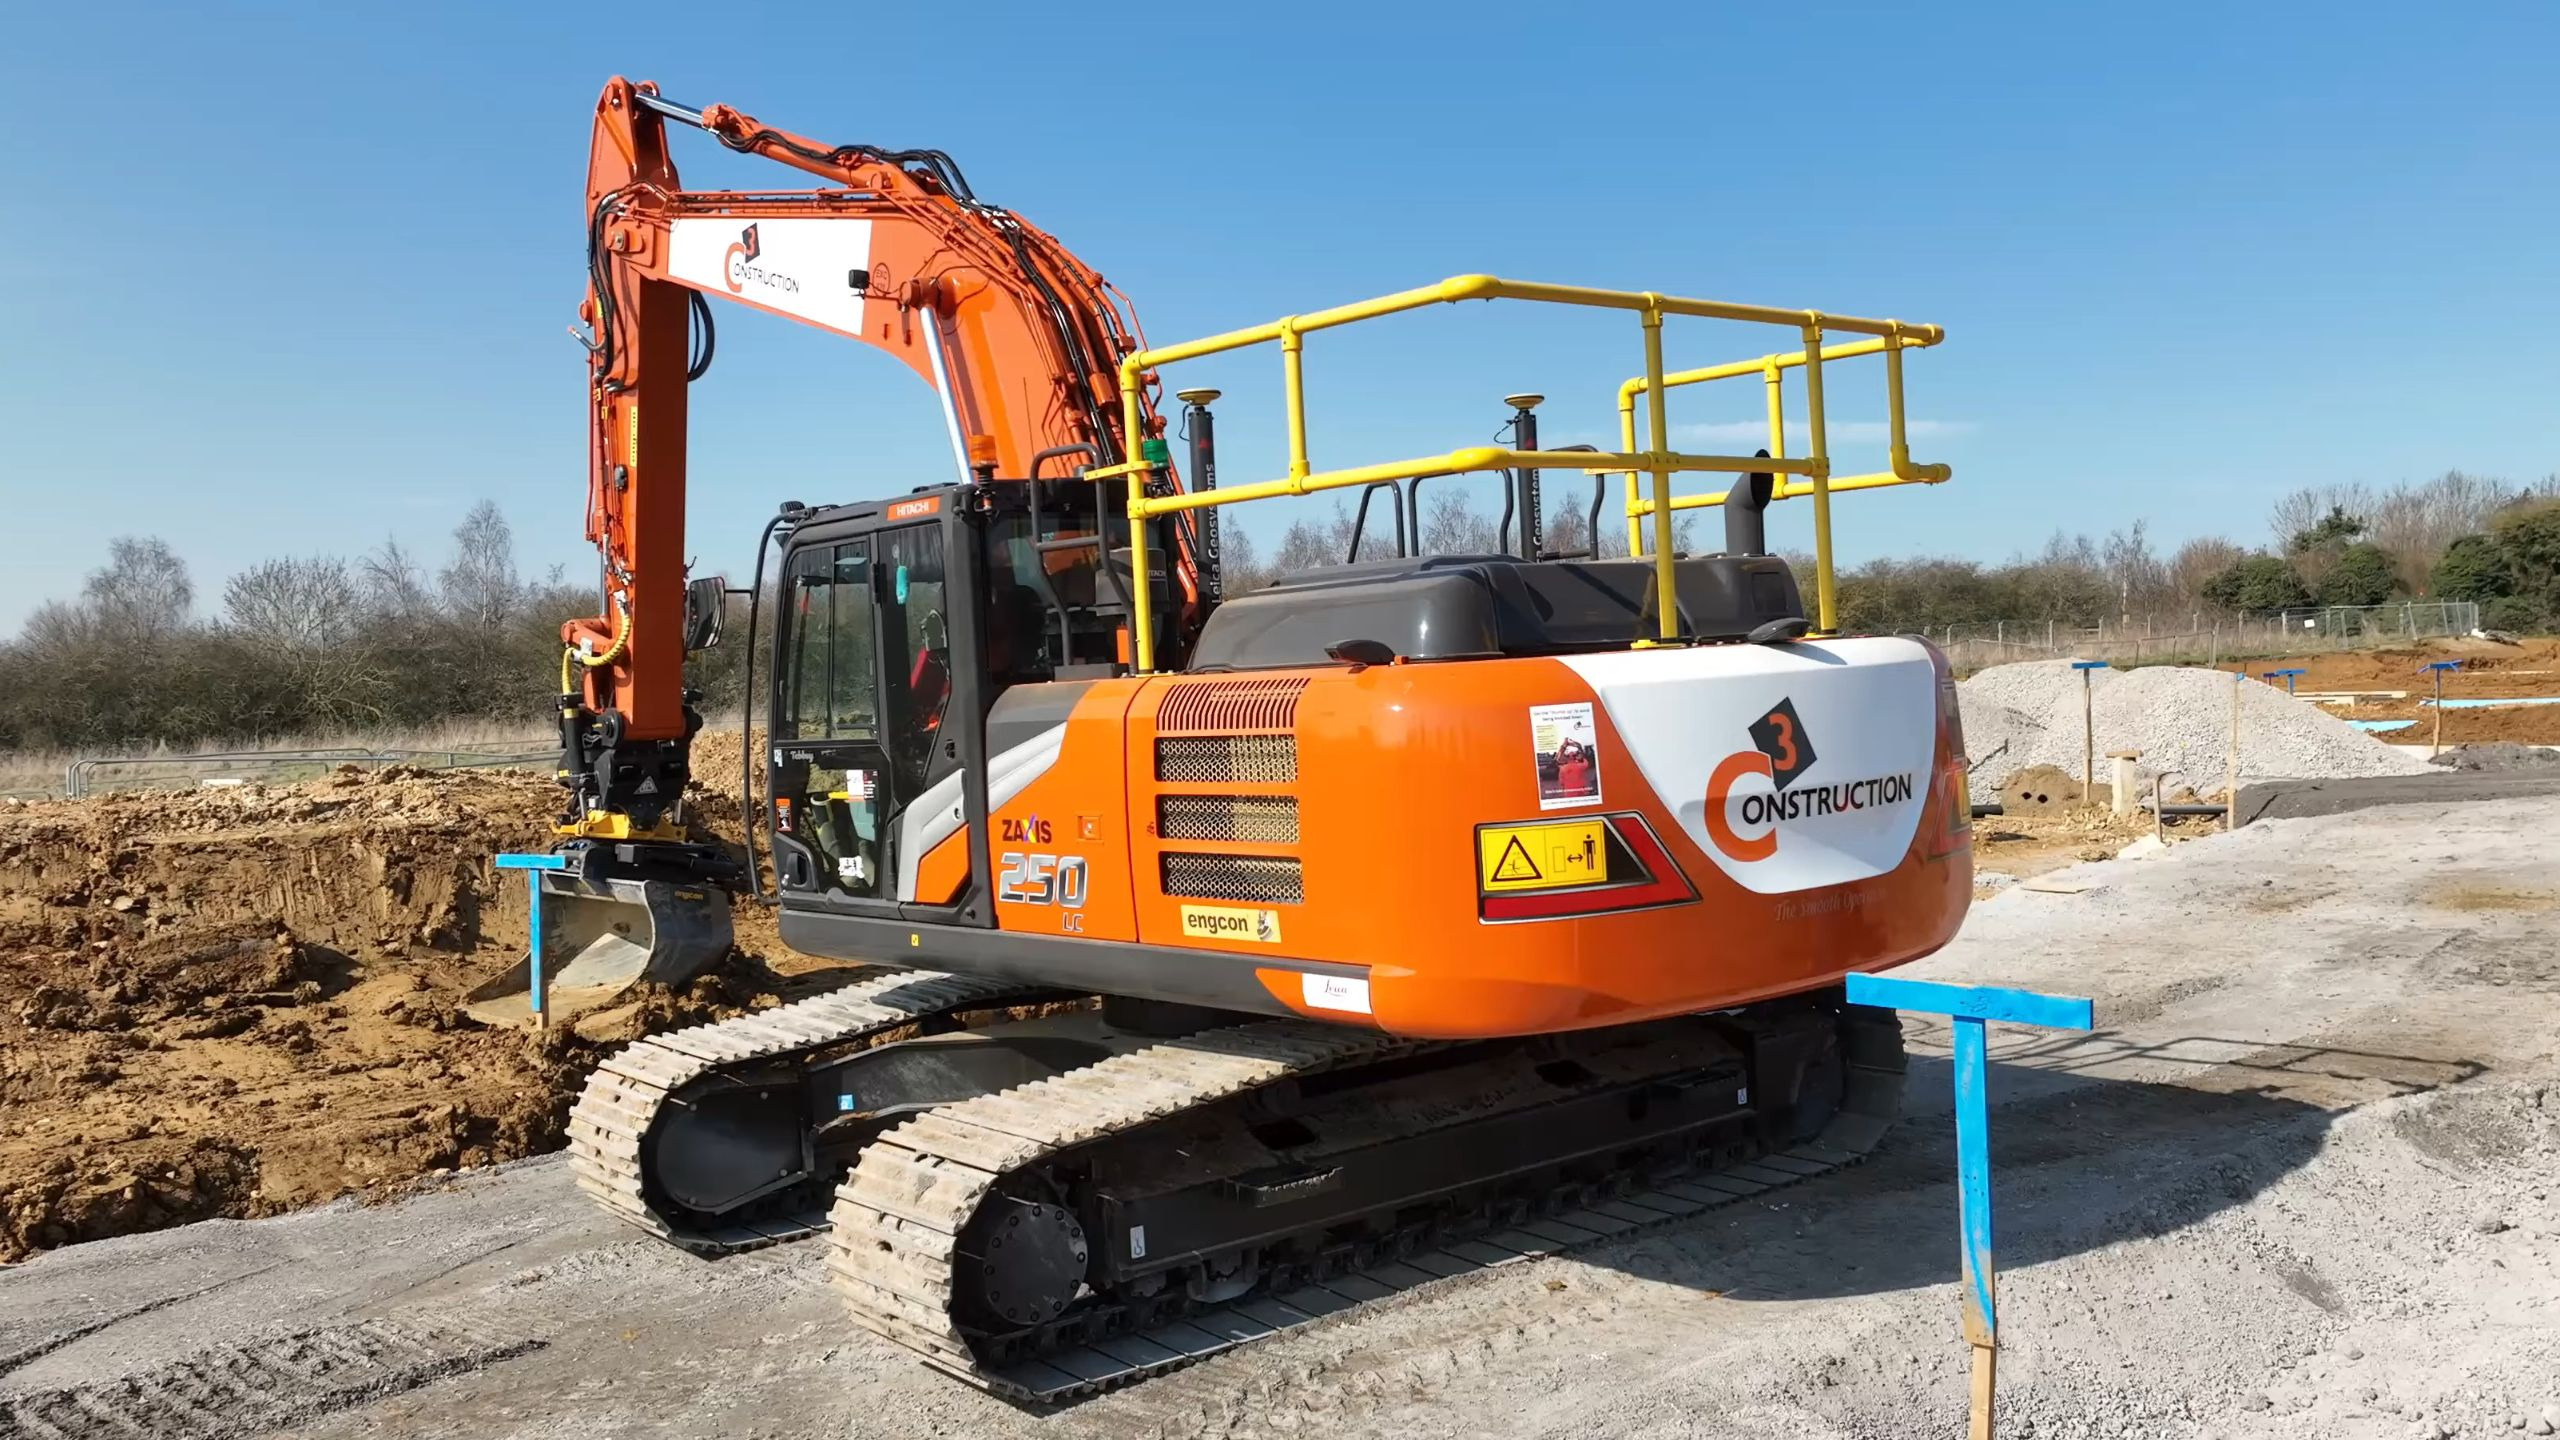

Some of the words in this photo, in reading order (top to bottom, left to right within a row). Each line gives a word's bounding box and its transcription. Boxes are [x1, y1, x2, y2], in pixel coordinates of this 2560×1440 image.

[896, 501, 929, 517] HITACHI
[1209, 563, 1222, 604] Leica
[1768, 712, 1798, 771] 3
[1002, 814, 1053, 844] ZAXIS
[999, 852, 1088, 909] 250
[1062, 912, 1084, 933] LC
[1188, 913, 1249, 934] engcon
